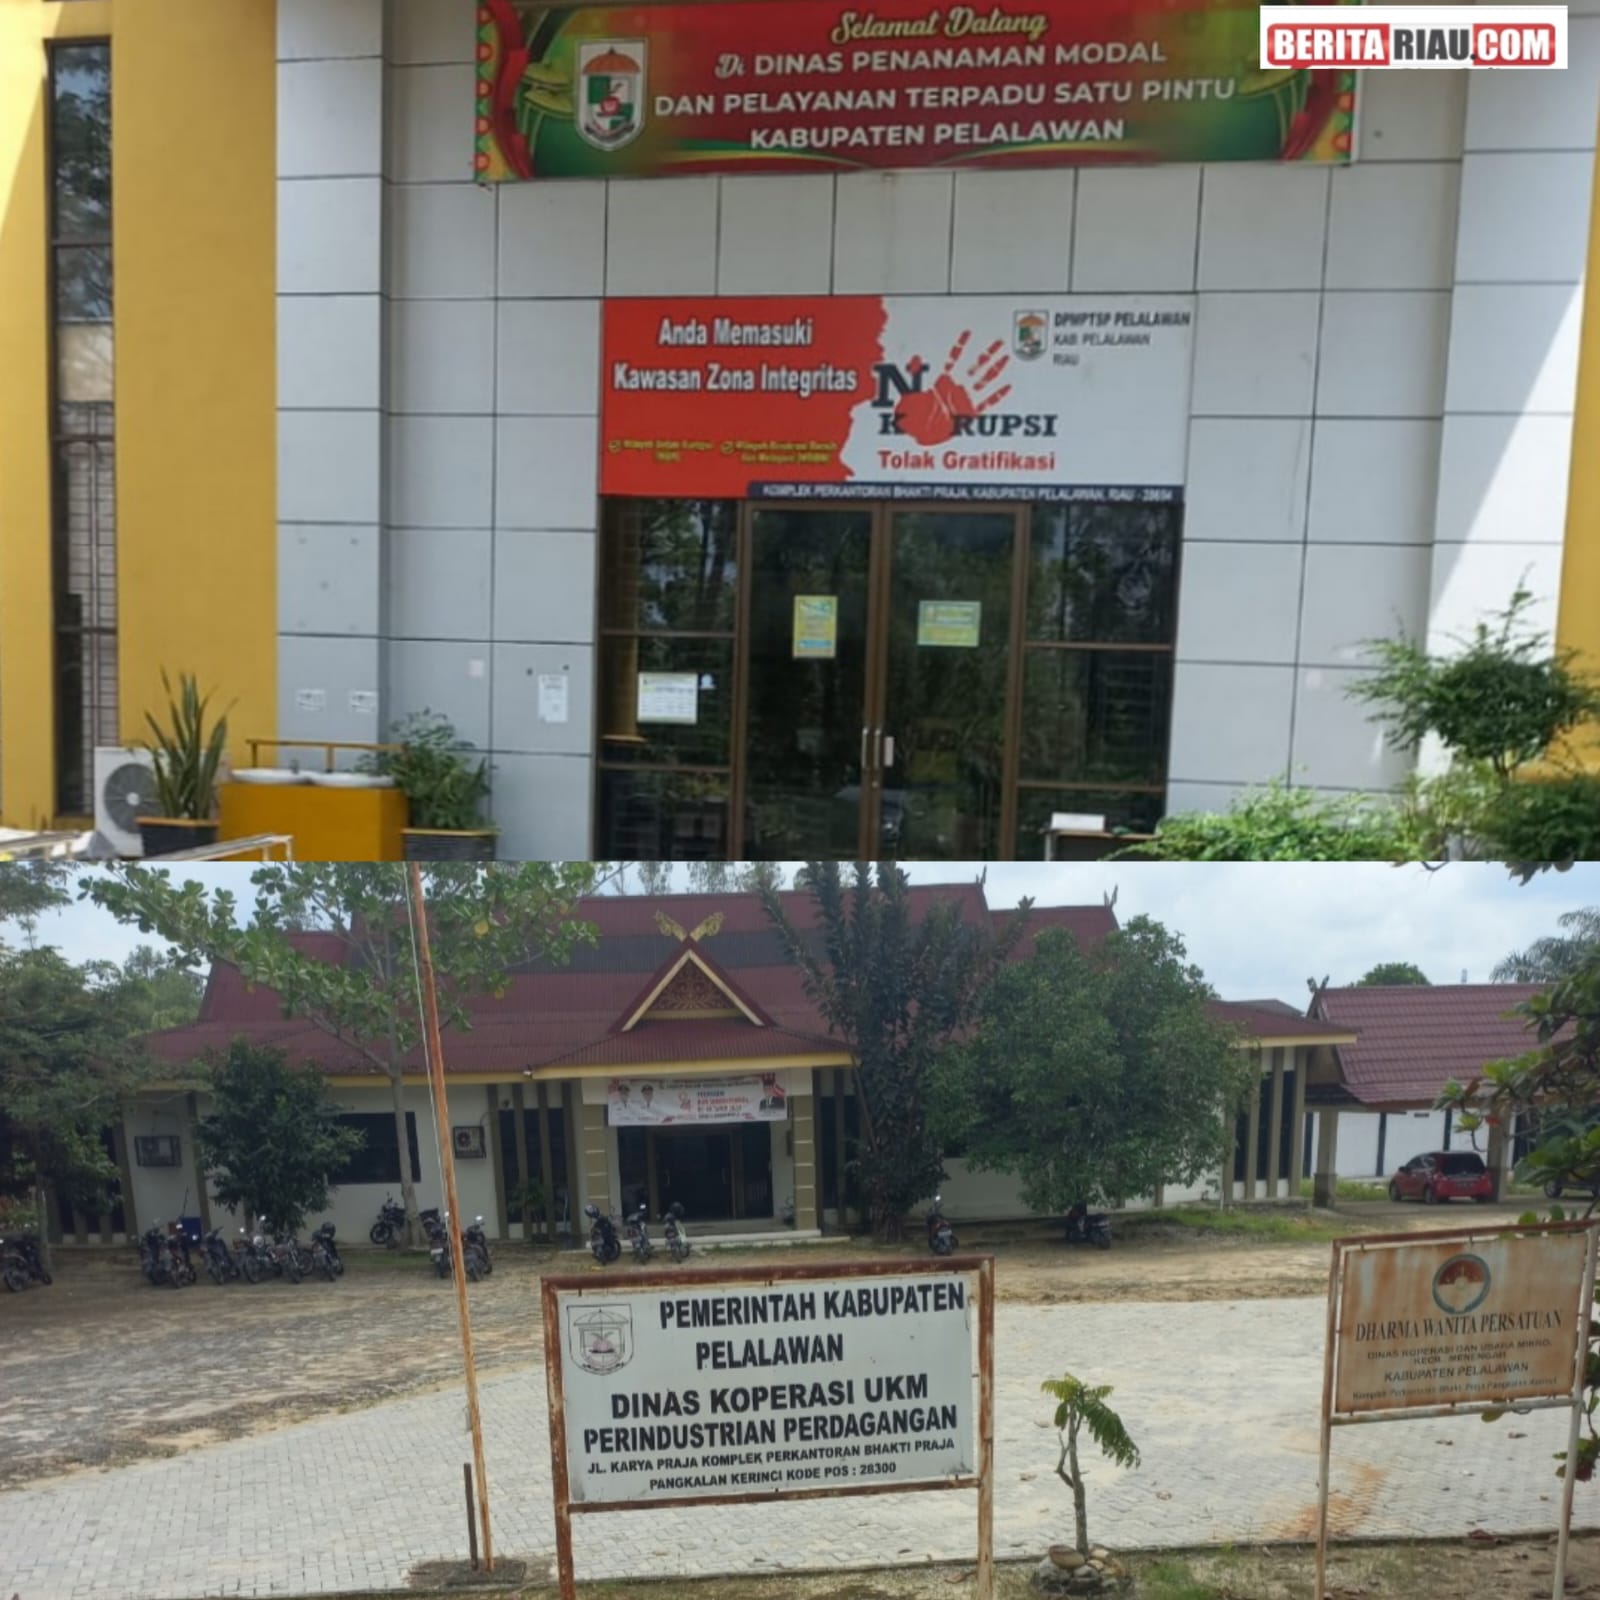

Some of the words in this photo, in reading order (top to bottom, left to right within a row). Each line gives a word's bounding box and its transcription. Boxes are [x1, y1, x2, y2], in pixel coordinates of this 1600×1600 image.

[831, 11, 939, 44] Selamat
[944, 8, 1048, 40] Datang
[754, 53, 843, 76] DINAS
[852, 45, 1043, 73] PENANAMAN
[1055, 41, 1167, 65] MODAL
[655, 96, 714, 117] DAN
[723, 91, 897, 114] PELAYANAN
[905, 85, 1044, 109] TERPADU
[1055, 82, 1133, 105] SATU
[1142, 78, 1235, 102] PINTU
[750, 126, 927, 150] KABUPATEN
[934, 118, 1125, 146] PELALAWAN
[658, 317, 708, 345] Anda
[713, 317, 813, 345] Memasuki
[1115, 312, 1191, 327] PELALAWAN
[1082, 333, 1151, 346] PELALAWAN
[613, 362, 701, 390] Kawasan
[706, 362, 755, 390] Zona
[761, 362, 858, 398] Integritas
[878, 450, 934, 470] Tolak
[942, 450, 1056, 471] Gratifikasi
[659, 1293, 817, 1330] PEMERINTAH
[823, 1281, 965, 1320] KABUPATEN
[1355, 1322, 1420, 1342] DHARMA
[1423, 1316, 1478, 1337] WANITA
[1480, 1310, 1562, 1332] PERSATUAN
[696, 1333, 844, 1371] PELALAWAN
[1384, 1367, 1455, 1384] KABUPATEN
[1457, 1361, 1529, 1378] PELALAWAN
[611, 1389, 700, 1419] DINAS
[709, 1379, 854, 1413] KOPERASI
[863, 1373, 929, 1402] UKM
[584, 1419, 777, 1453] PERINDUSTRIAN
[783, 1404, 958, 1442] PERDAGANGAN
[588, 1462, 606, 1474] JL.
[610, 1458, 653, 1472] KARYA
[656, 1456, 699, 1470] PRAJA
[701, 1451, 763, 1468] KOMPLEK
[766, 1446, 861, 1463] PERKANTORAN
[864, 1441, 911, 1457] BHAKTI
[914, 1437, 955, 1452] PRAJA
[649, 1474, 729, 1491] PANGKALAN
[730, 1470, 783, 1485] KERINCI
[786, 1468, 821, 1481] KODE
[824, 1465, 849, 1478] POS
[860, 1461, 897, 1475] 28300
